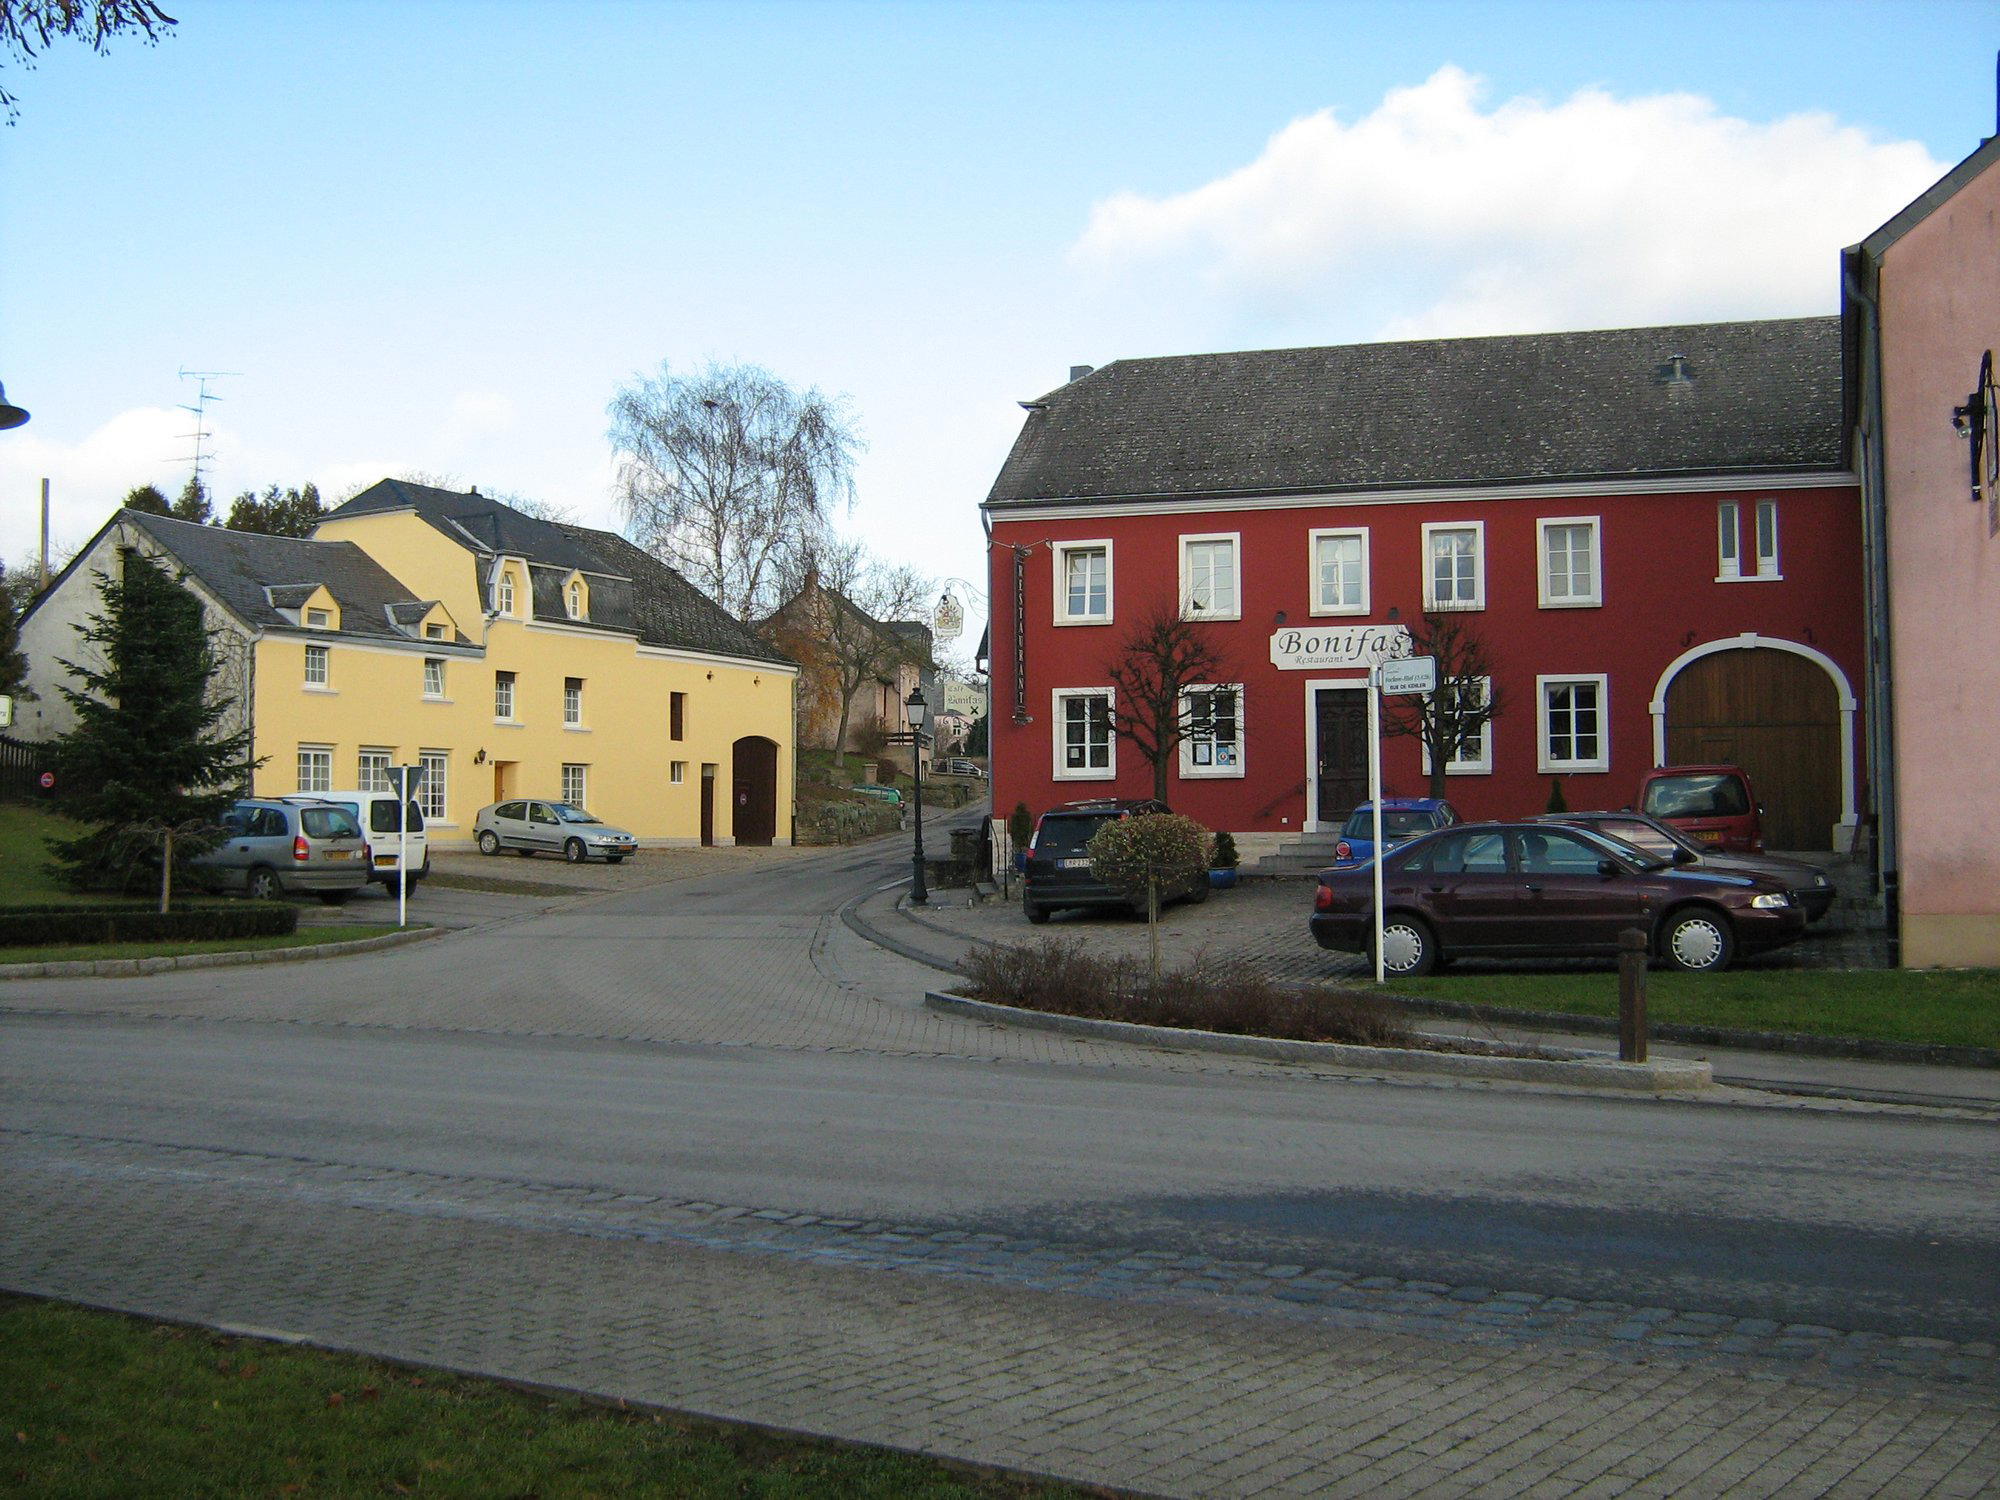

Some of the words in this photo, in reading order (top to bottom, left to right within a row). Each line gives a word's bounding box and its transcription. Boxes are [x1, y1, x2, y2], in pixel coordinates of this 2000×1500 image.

[1278, 628, 1404, 661] Bonifas
[1294, 655, 1344, 664] Restaurant
[948, 695, 983, 704] Bonifas
